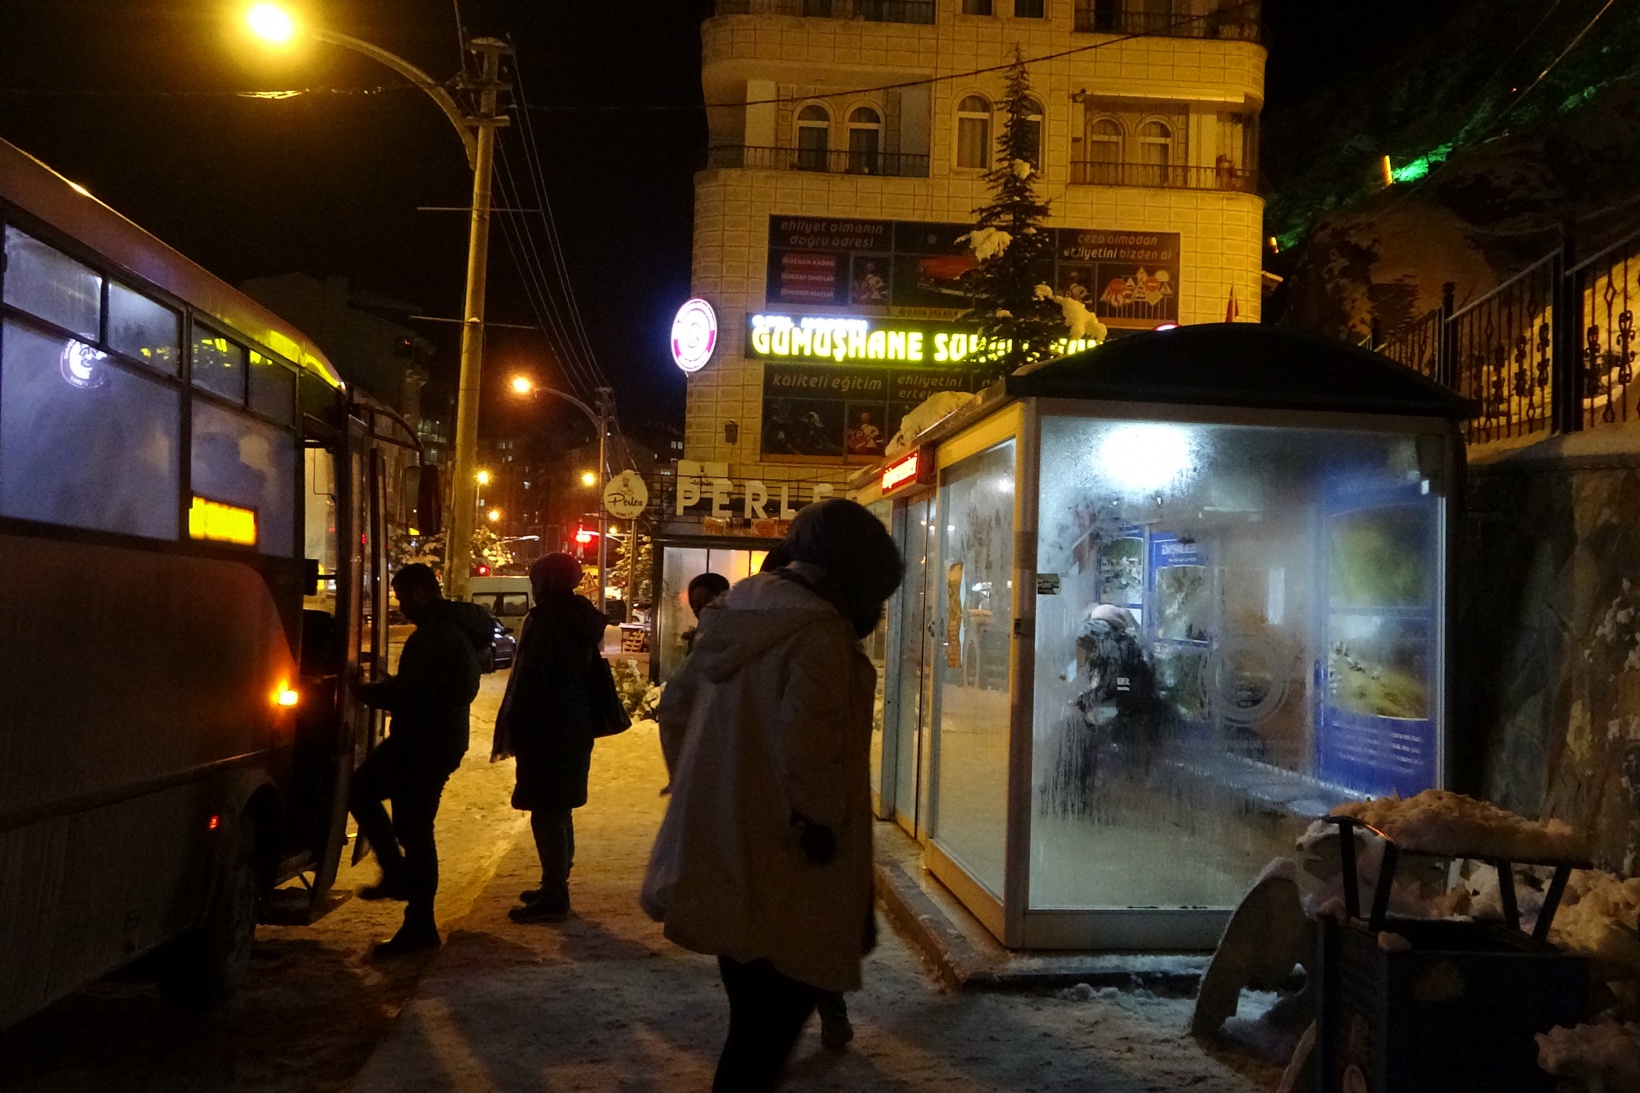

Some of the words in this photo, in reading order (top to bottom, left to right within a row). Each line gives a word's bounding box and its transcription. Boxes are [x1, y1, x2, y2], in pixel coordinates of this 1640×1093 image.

[1077, 234, 1105, 244] ceza
[752, 327, 923, 361] GÜMÜŞHANE
[772, 373, 829, 389] kaliteli
[831, 375, 883, 392] eğitim
[897, 375, 963, 389] ehliyetini
[608, 492, 643, 507] Perles
